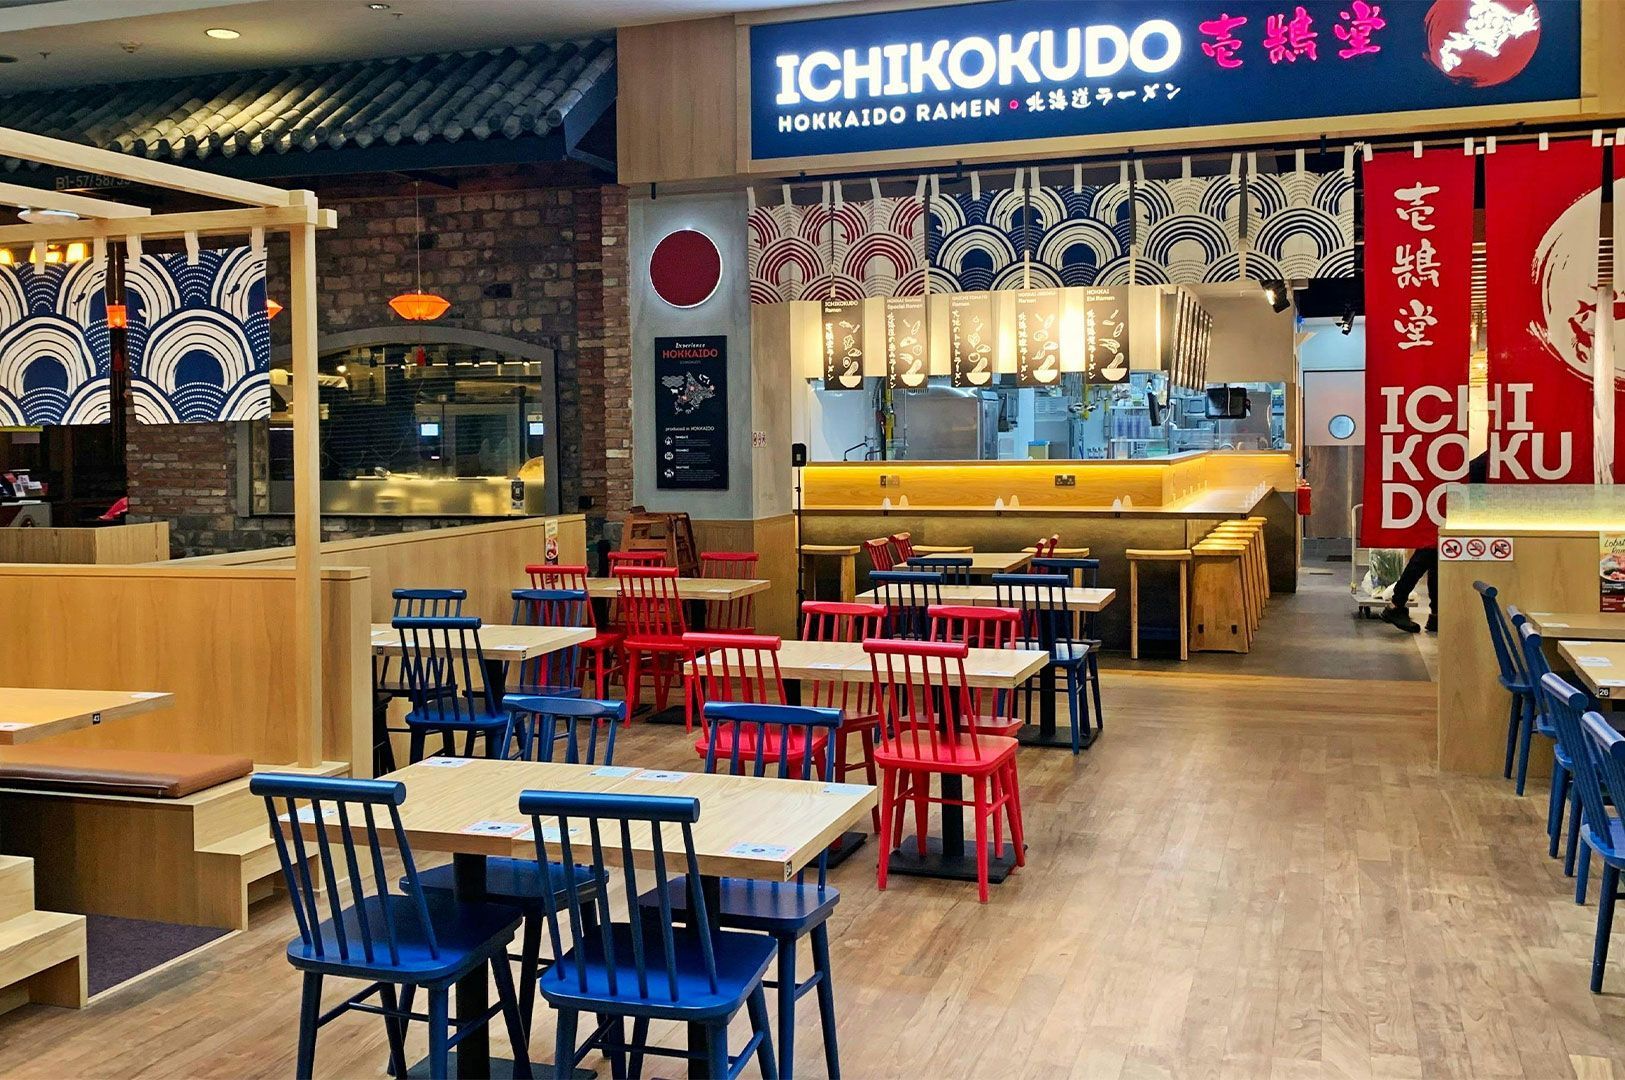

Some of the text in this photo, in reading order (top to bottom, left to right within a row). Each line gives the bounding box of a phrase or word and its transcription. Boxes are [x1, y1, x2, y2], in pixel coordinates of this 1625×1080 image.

[775, 19, 1182, 106] ICHIKOKUDO
[778, 97, 1001, 133] HOKKAIDO RAMEN
[1025, 83, 1181, 113] 北海道ラーメン
[662, 349, 718, 359] HOKKAIDO
[1380, 383, 1534, 433] ICHI
[1382, 431, 1573, 481] KOKU
[1600, 688, 1608, 696] 26
